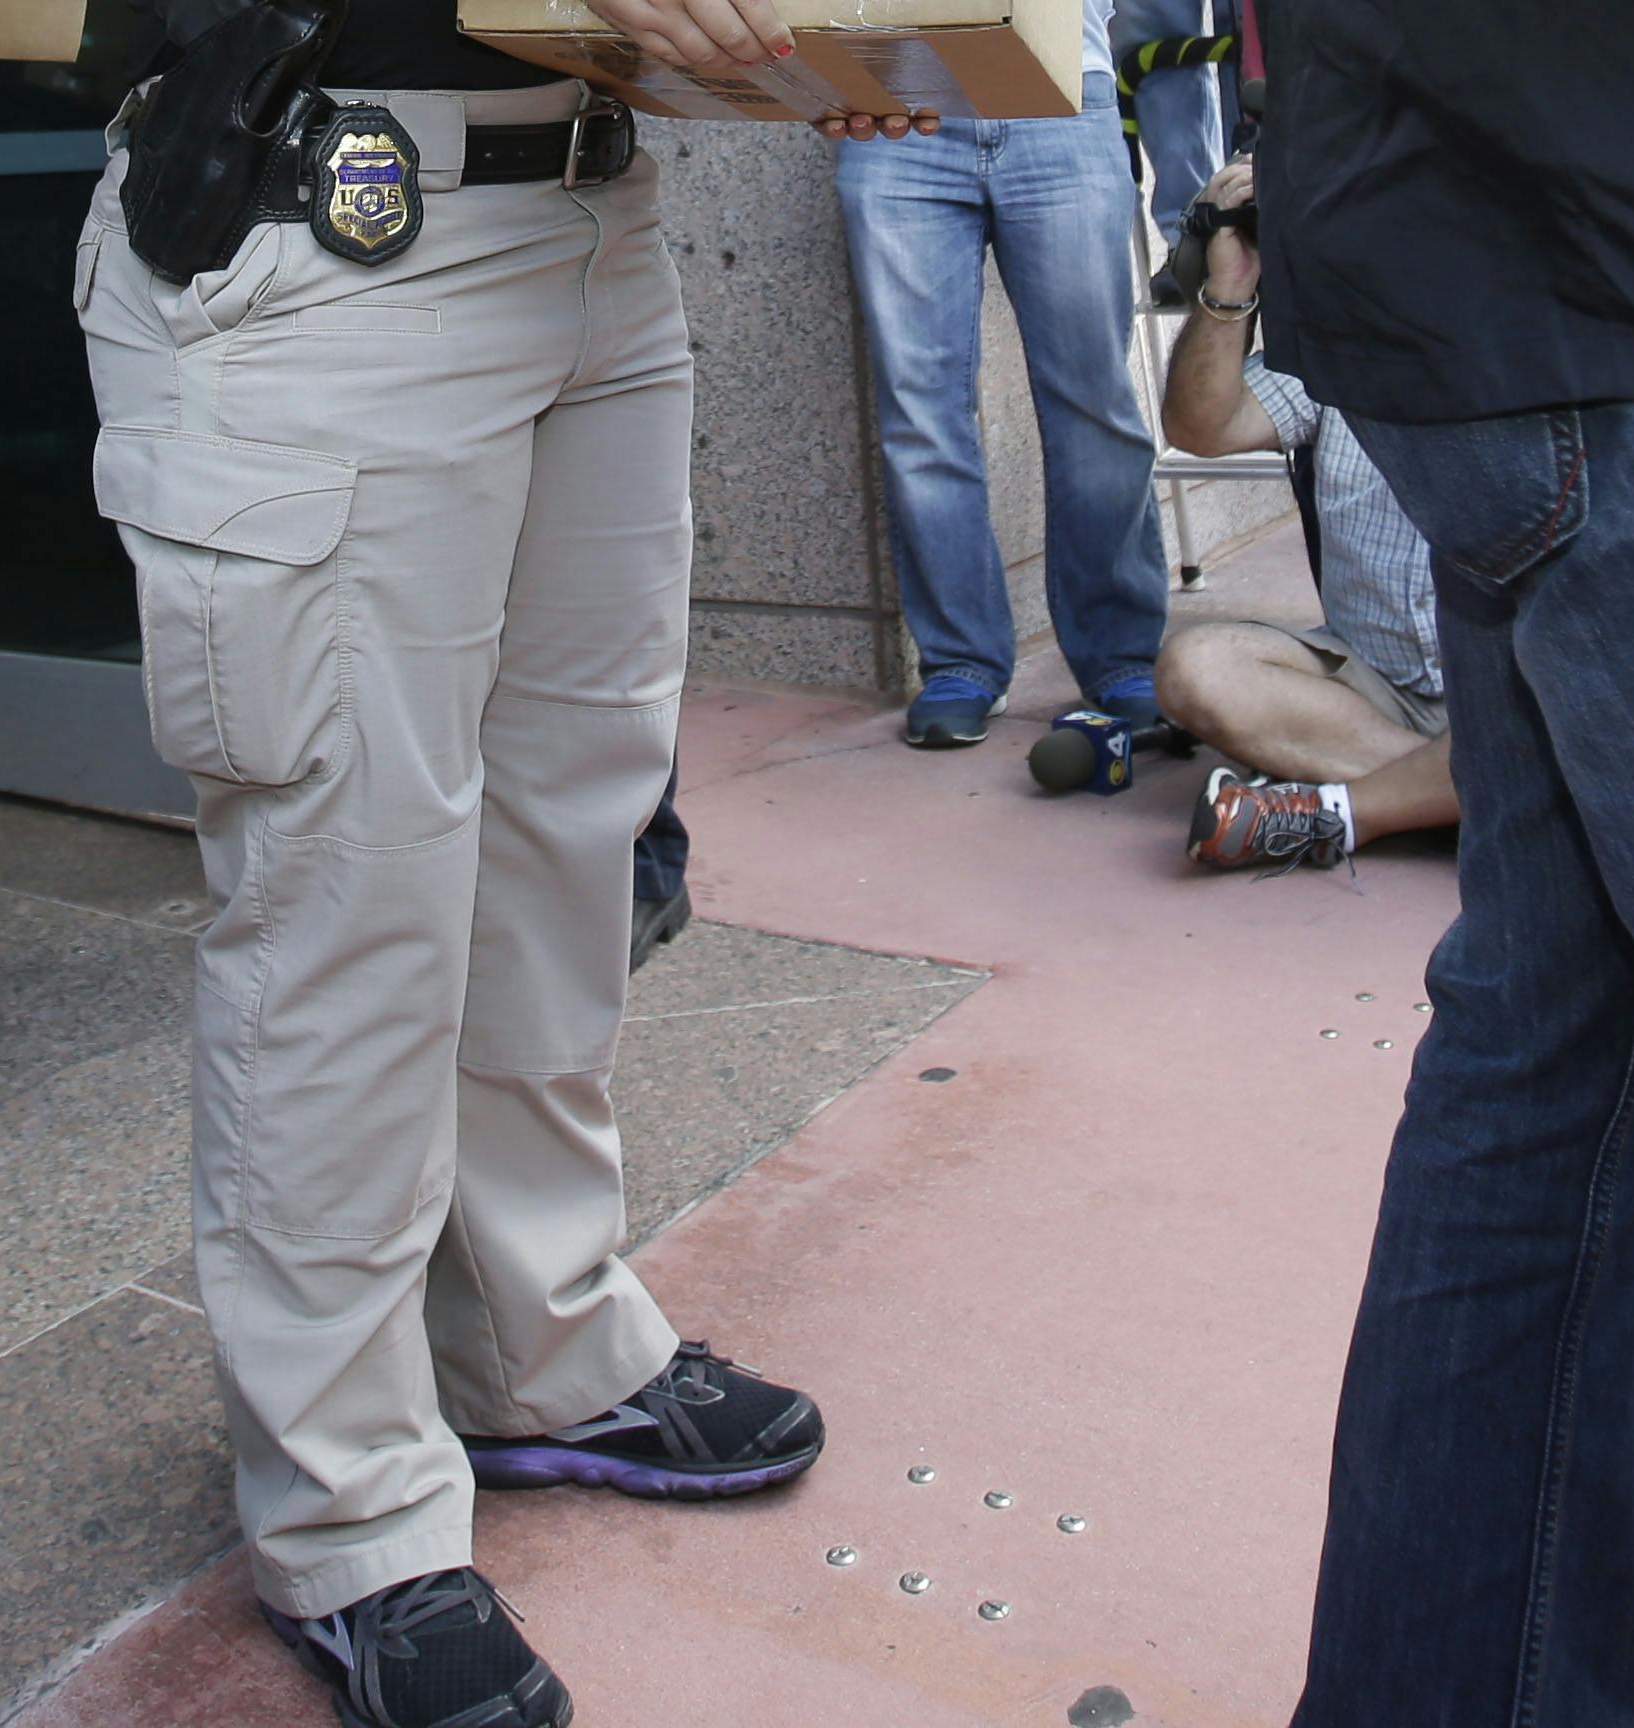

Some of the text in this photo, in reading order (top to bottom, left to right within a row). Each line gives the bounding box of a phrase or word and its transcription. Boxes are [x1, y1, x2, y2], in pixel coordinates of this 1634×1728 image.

[345, 174, 394, 183] TREASURY
[338, 188, 400, 206] U S
[1107, 731, 1127, 758] 4
